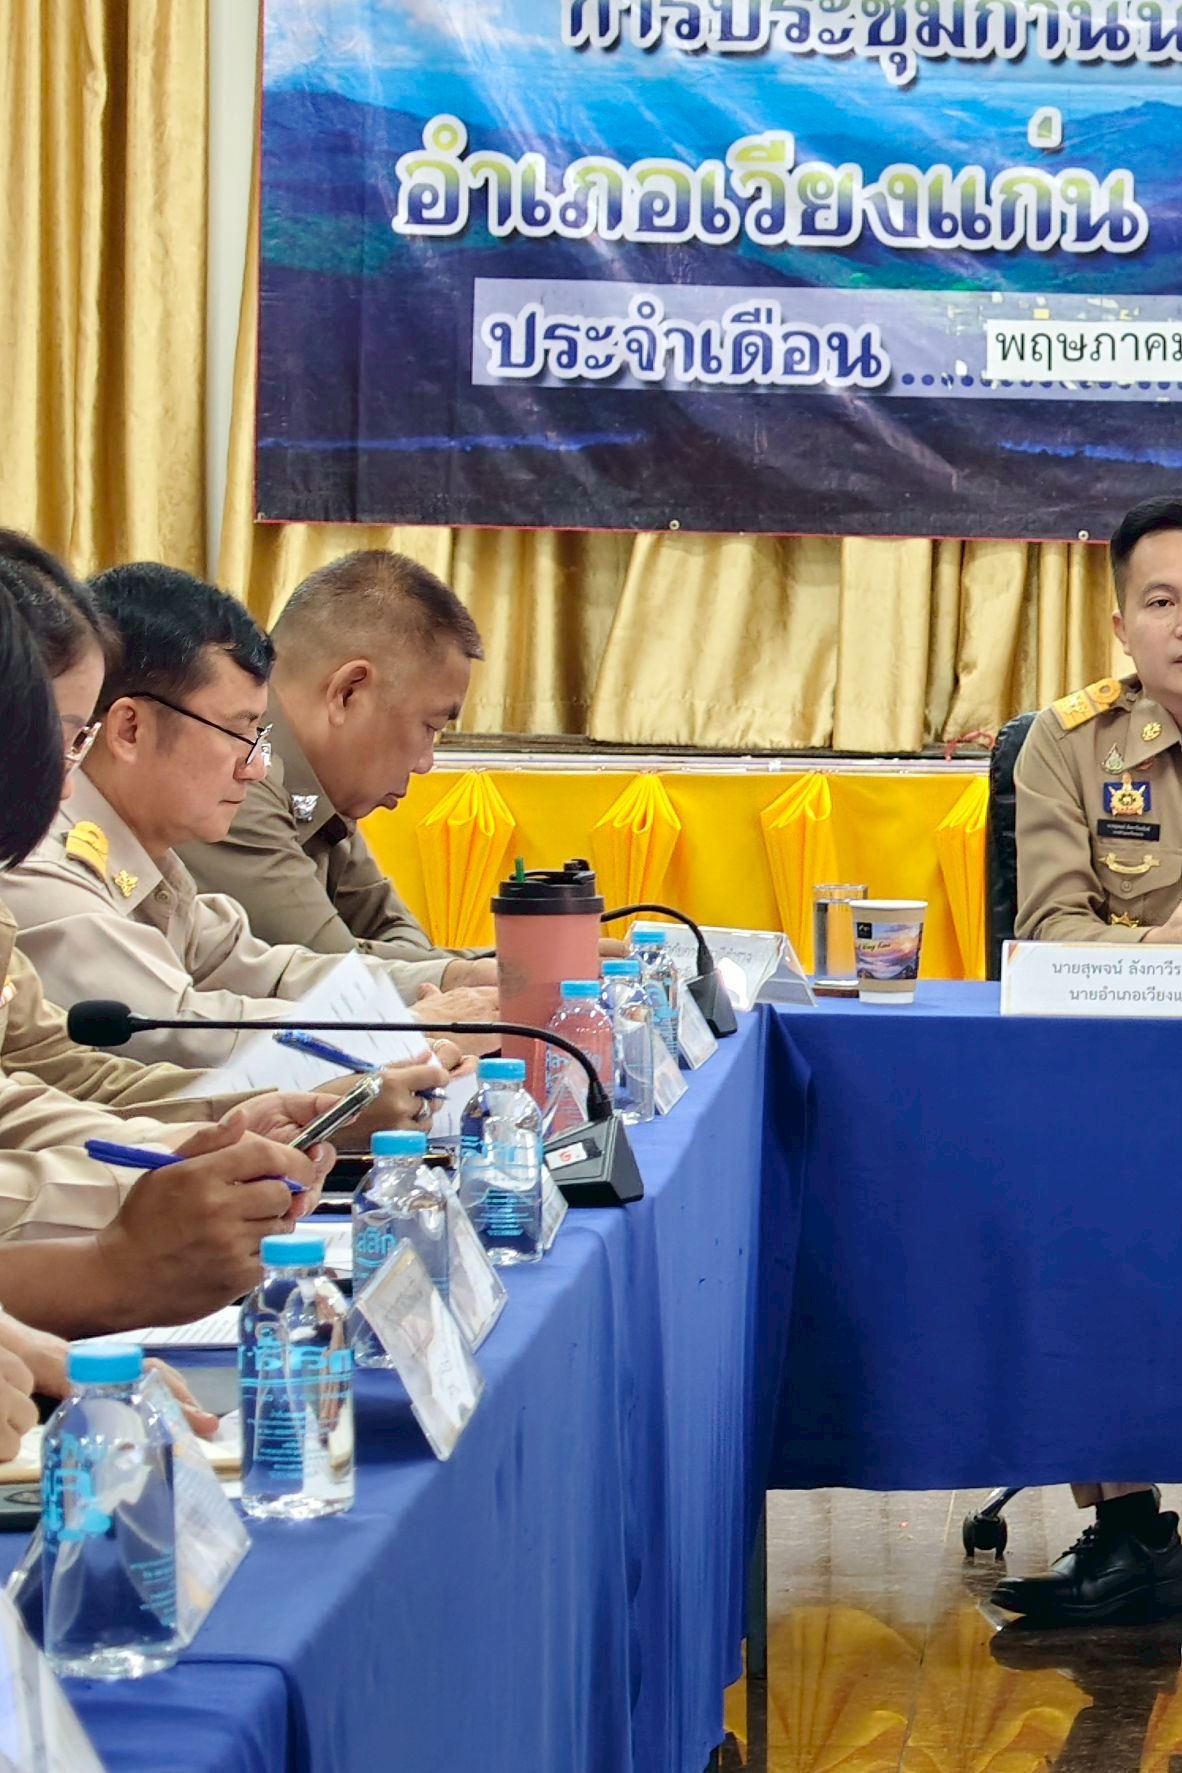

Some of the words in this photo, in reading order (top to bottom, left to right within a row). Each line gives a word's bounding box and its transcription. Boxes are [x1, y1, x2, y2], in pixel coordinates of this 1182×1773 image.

[393, 106, 1148, 253] อำเภอเวียงแก่น
[482, 293, 890, 389] ประจำเดือน
[1052, 958, 1124, 979] นายสุพจน์
